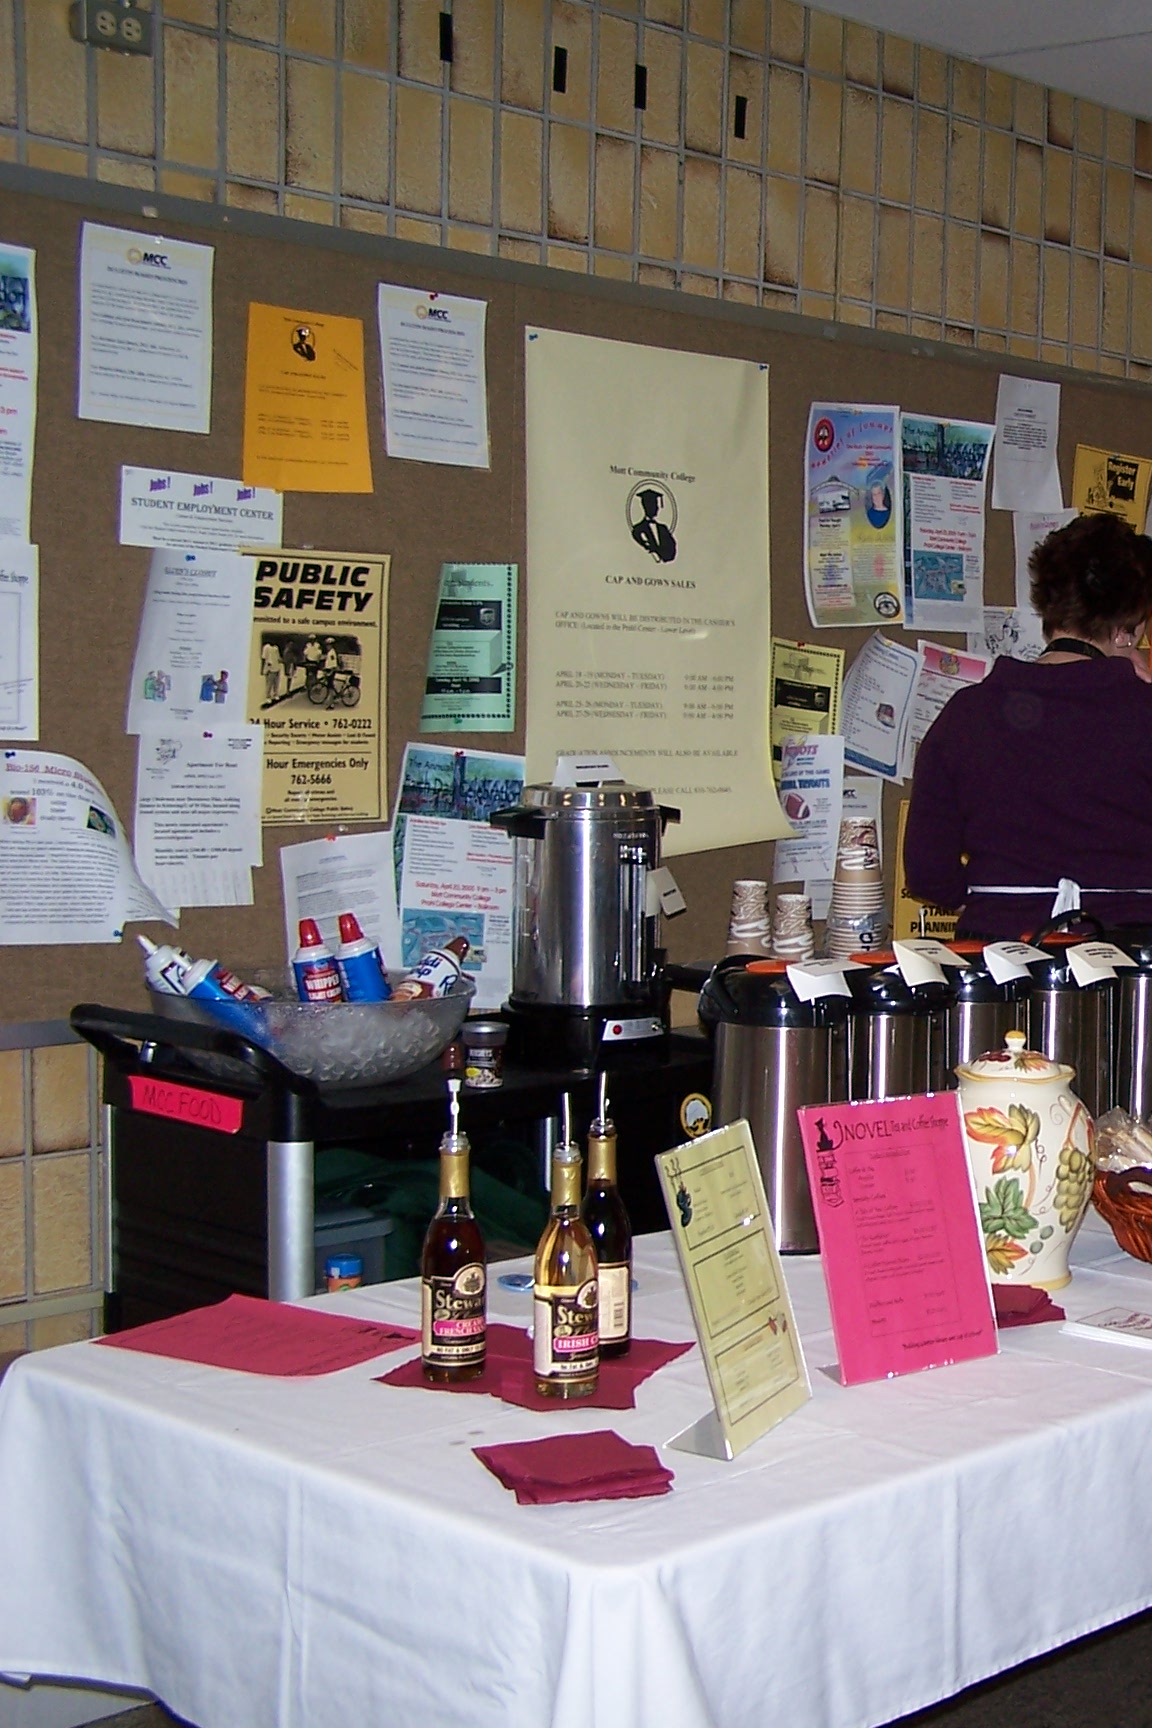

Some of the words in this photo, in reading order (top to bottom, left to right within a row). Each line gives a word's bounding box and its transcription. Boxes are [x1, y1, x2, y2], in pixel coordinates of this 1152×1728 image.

[143, 252, 168, 266] MCC
[427, 306, 449, 321] MCC
[609, 464, 627, 476] Mott
[670, 471, 695, 483] College
[131, 497, 174, 511] STUDENT
[176, 501, 239, 517] EMPLOYMENT
[239, 507, 274, 521] CENTER
[256, 560, 371, 588] PUBLIC
[605, 575, 624, 584] CAP
[626, 576, 643, 586] AND
[644, 577, 670, 587] GOWN
[671, 579, 696, 589] SALES
[254, 586, 374, 612] SAFETY
[297, 616, 310, 625] safe
[264, 719, 285, 729] Hour
[288, 718, 321, 729] Service
[332, 718, 372, 729] 762-0222
[266, 758, 289, 770] Hour
[292, 758, 347, 772] Emergencies
[348, 758, 370, 771] Only
[291, 774, 333, 785] 762-5666
[179, 1091, 221, 1124] FOOD
[844, 1120, 893, 1141] NOVEL
[557, 1337, 589, 1350] IRISH
